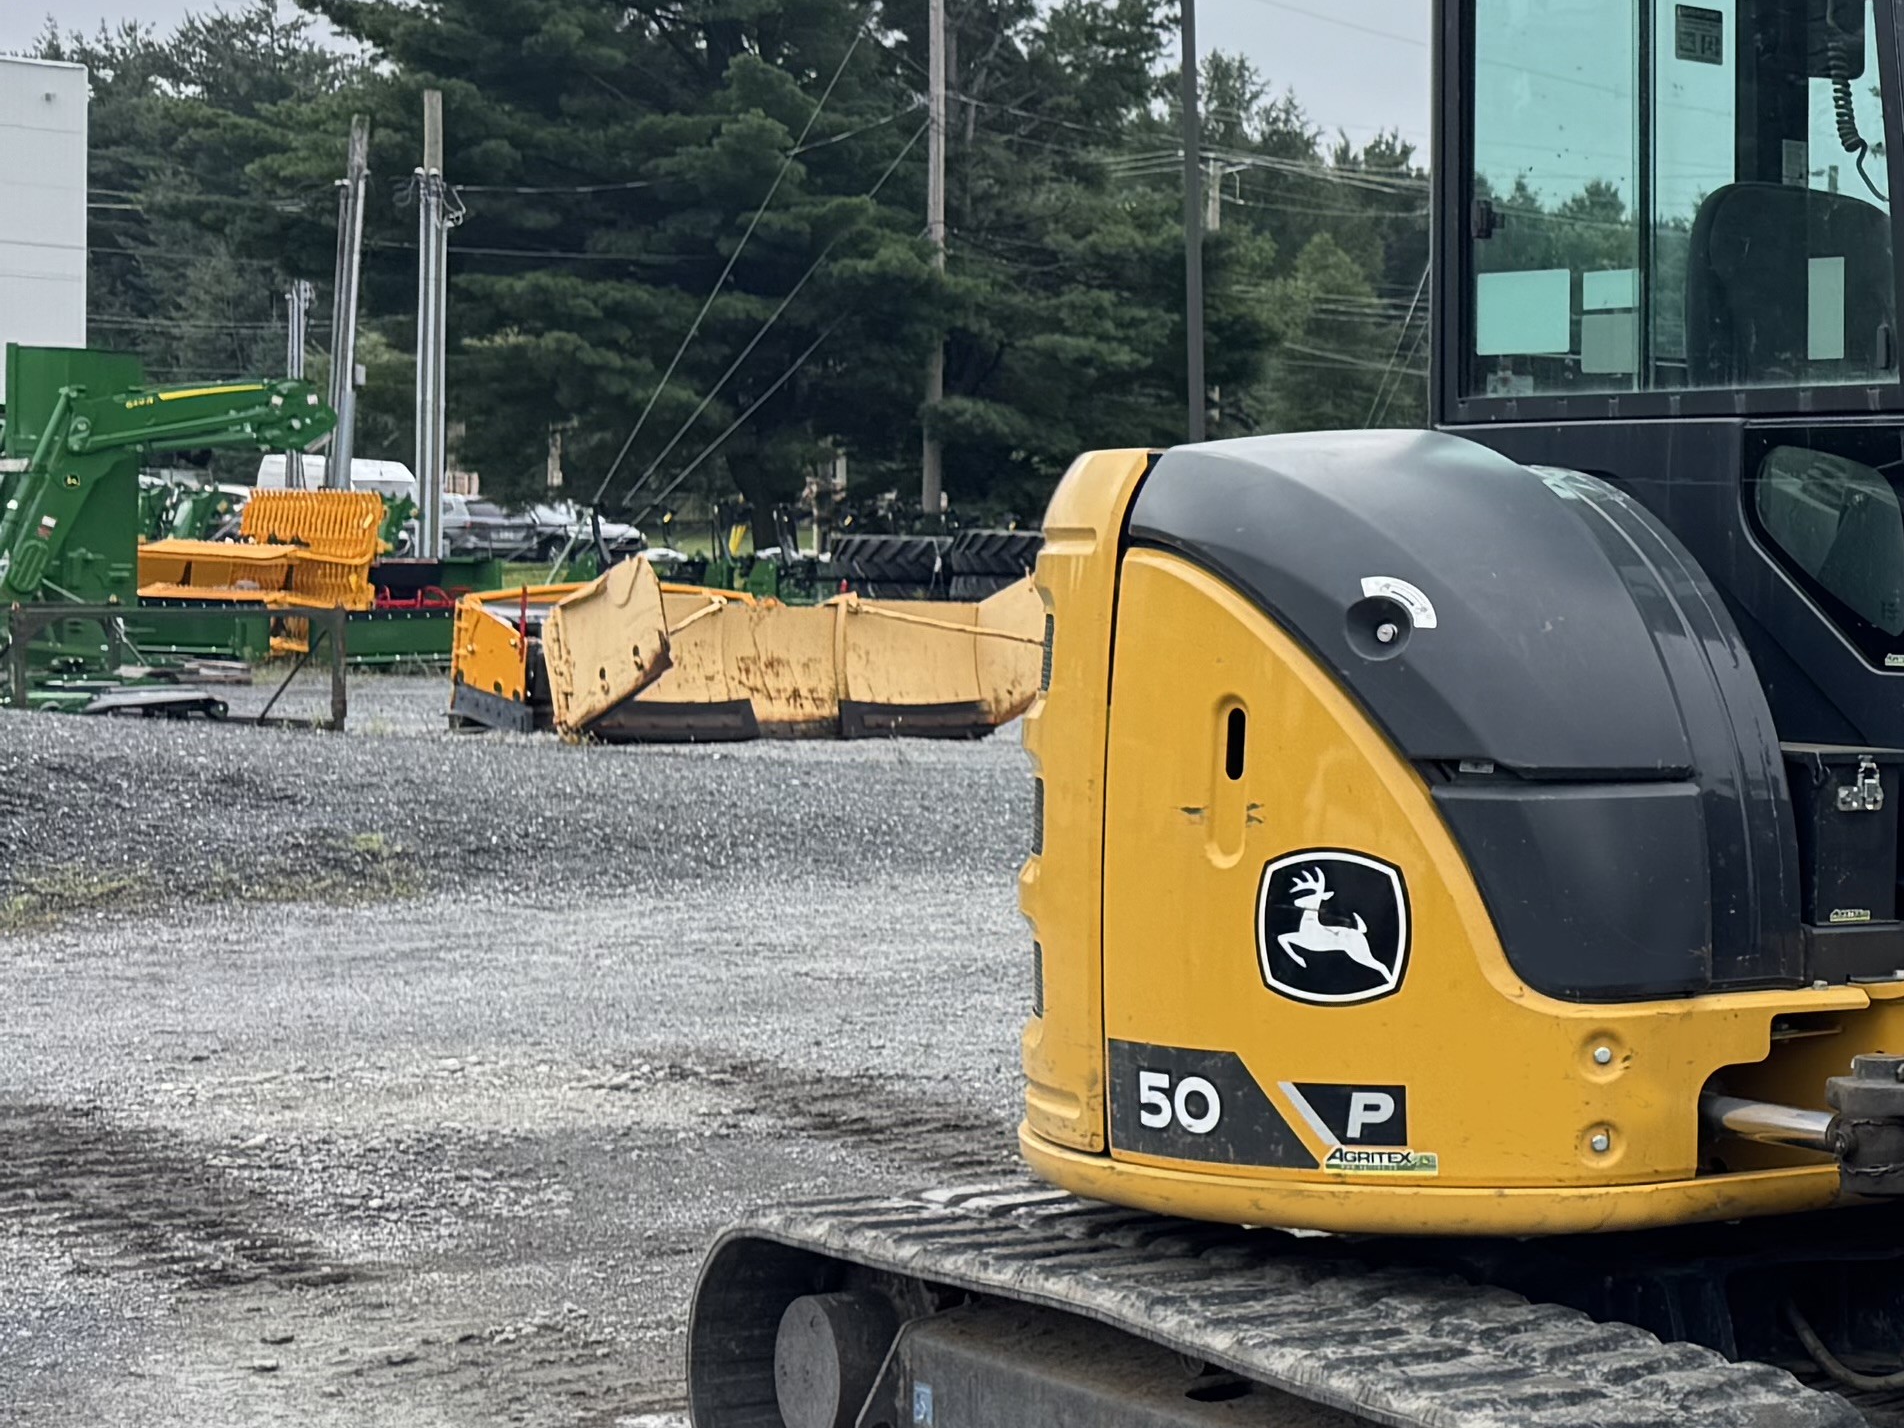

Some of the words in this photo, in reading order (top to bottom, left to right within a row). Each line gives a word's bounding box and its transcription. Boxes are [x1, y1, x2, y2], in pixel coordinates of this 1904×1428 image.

[1138, 1070, 1221, 1134] 50
[1346, 1091, 1395, 1138] P
[1326, 1147, 1412, 1164] AGRITEX
